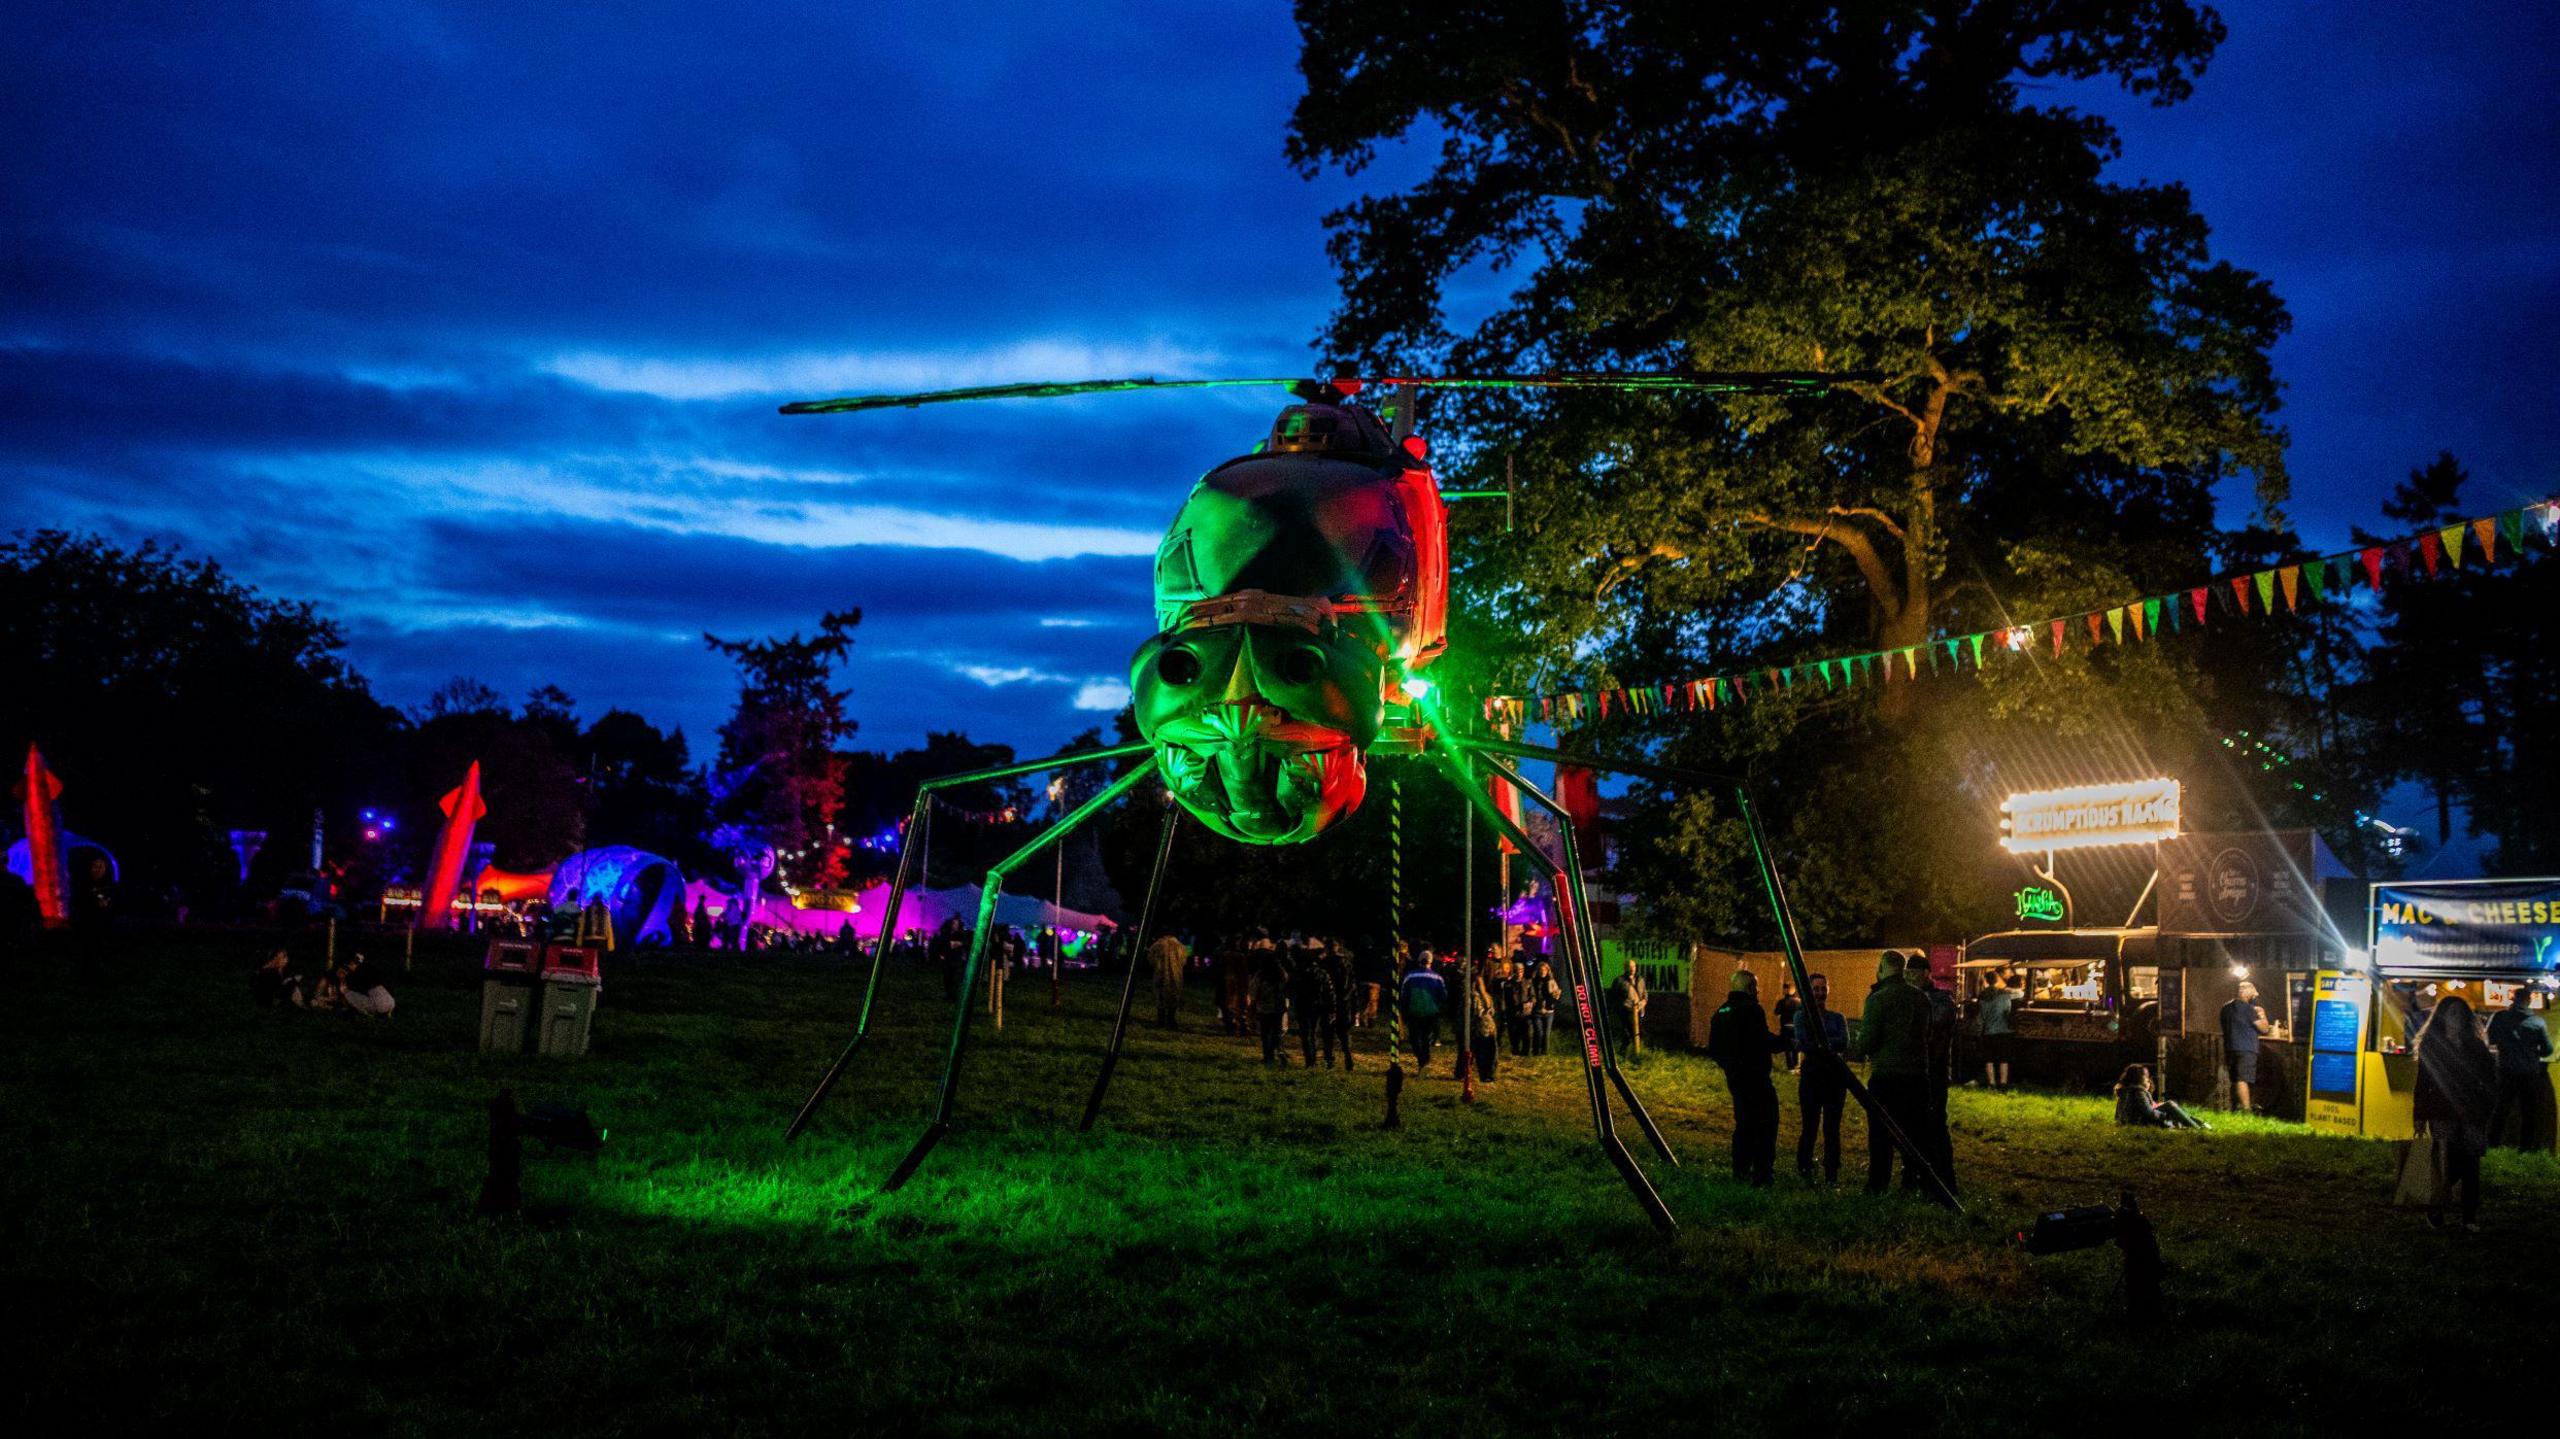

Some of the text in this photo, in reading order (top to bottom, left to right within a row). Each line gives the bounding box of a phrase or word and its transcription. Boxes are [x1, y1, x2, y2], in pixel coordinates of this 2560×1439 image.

[2382, 903, 2432, 924] MAC
[1576, 985, 1600, 1068] DO NOT CLIMB
